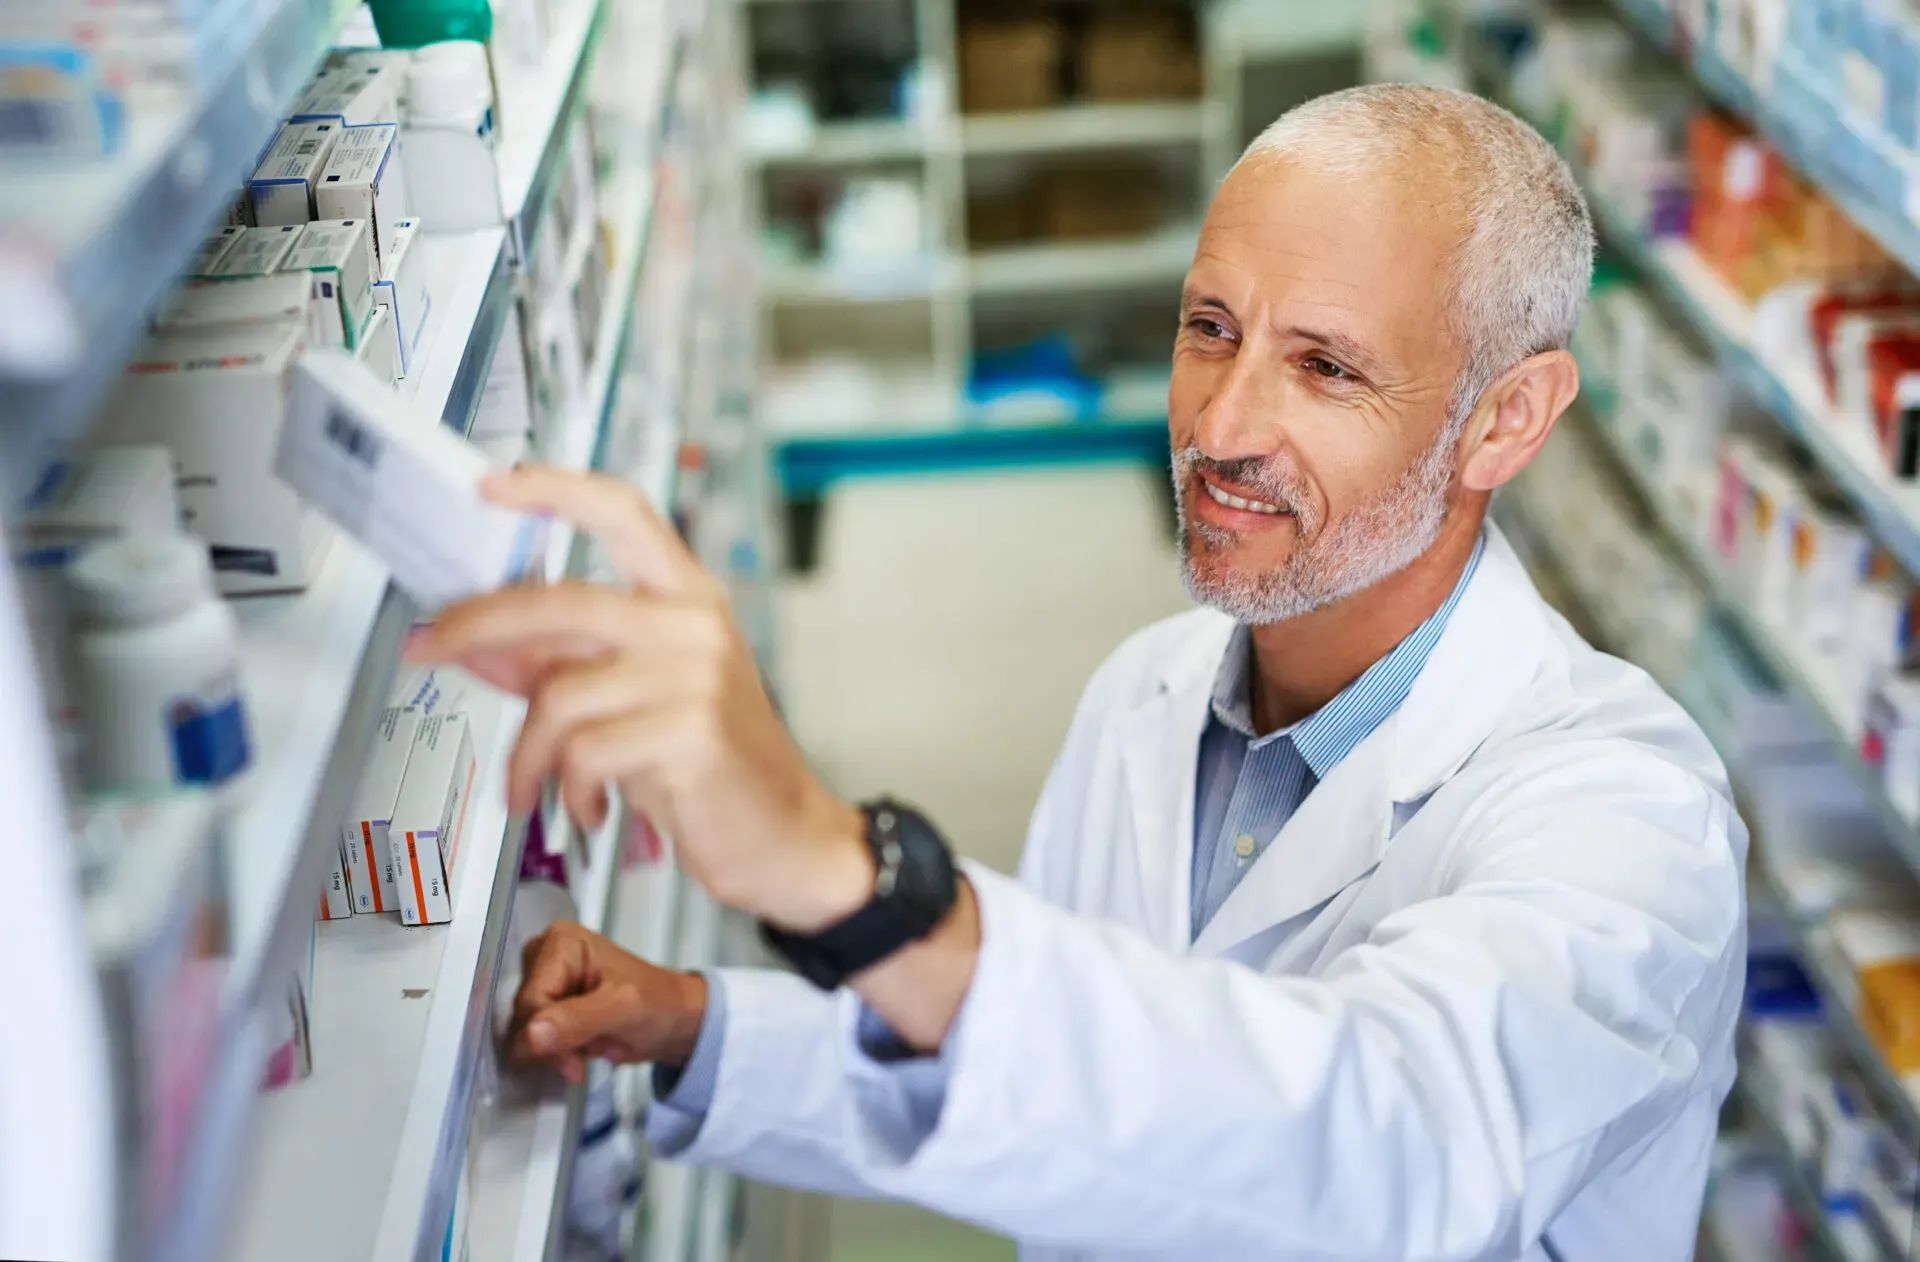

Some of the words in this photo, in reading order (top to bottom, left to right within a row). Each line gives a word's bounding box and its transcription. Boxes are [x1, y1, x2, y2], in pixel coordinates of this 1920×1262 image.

[386, 864, 393, 872] 15
[386, 873, 393, 883] mg
[431, 878, 439, 886] 15
[333, 880, 340, 891] mg
[431, 886, 439, 897] mg
